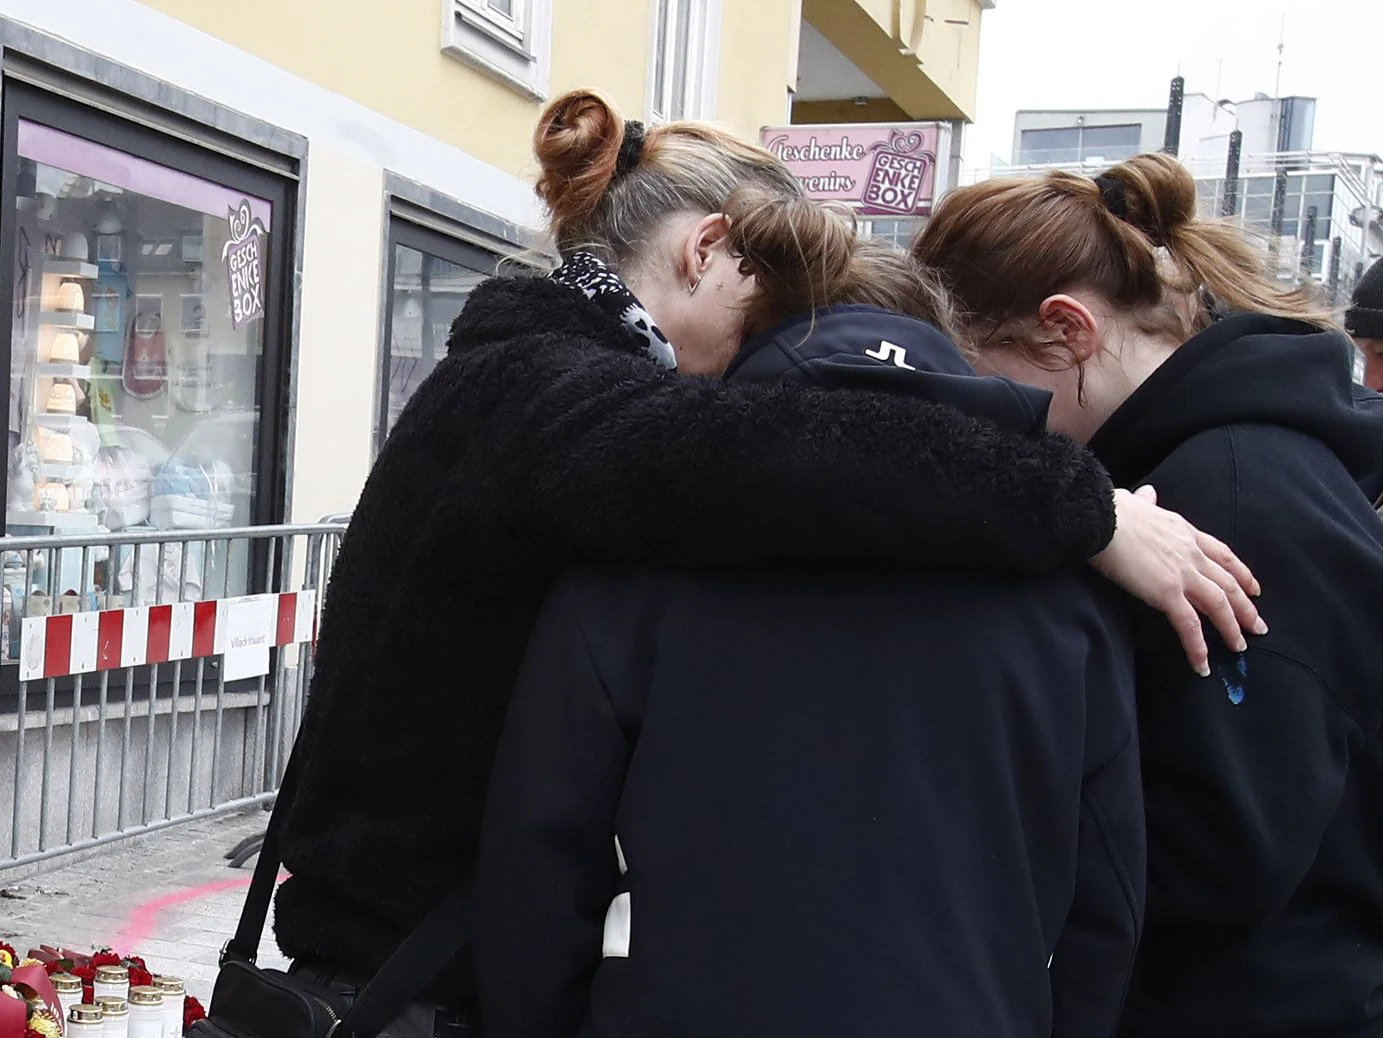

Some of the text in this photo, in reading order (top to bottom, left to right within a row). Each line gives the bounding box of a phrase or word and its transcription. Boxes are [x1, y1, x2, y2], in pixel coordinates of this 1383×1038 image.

[877, 154, 923, 174] GESCH
[872, 167, 920, 191] ENKE
[867, 183, 915, 210] BOX
[229, 241, 258, 272] GESCH
[231, 259, 260, 297] ENKE
[233, 283, 262, 323] BOX
